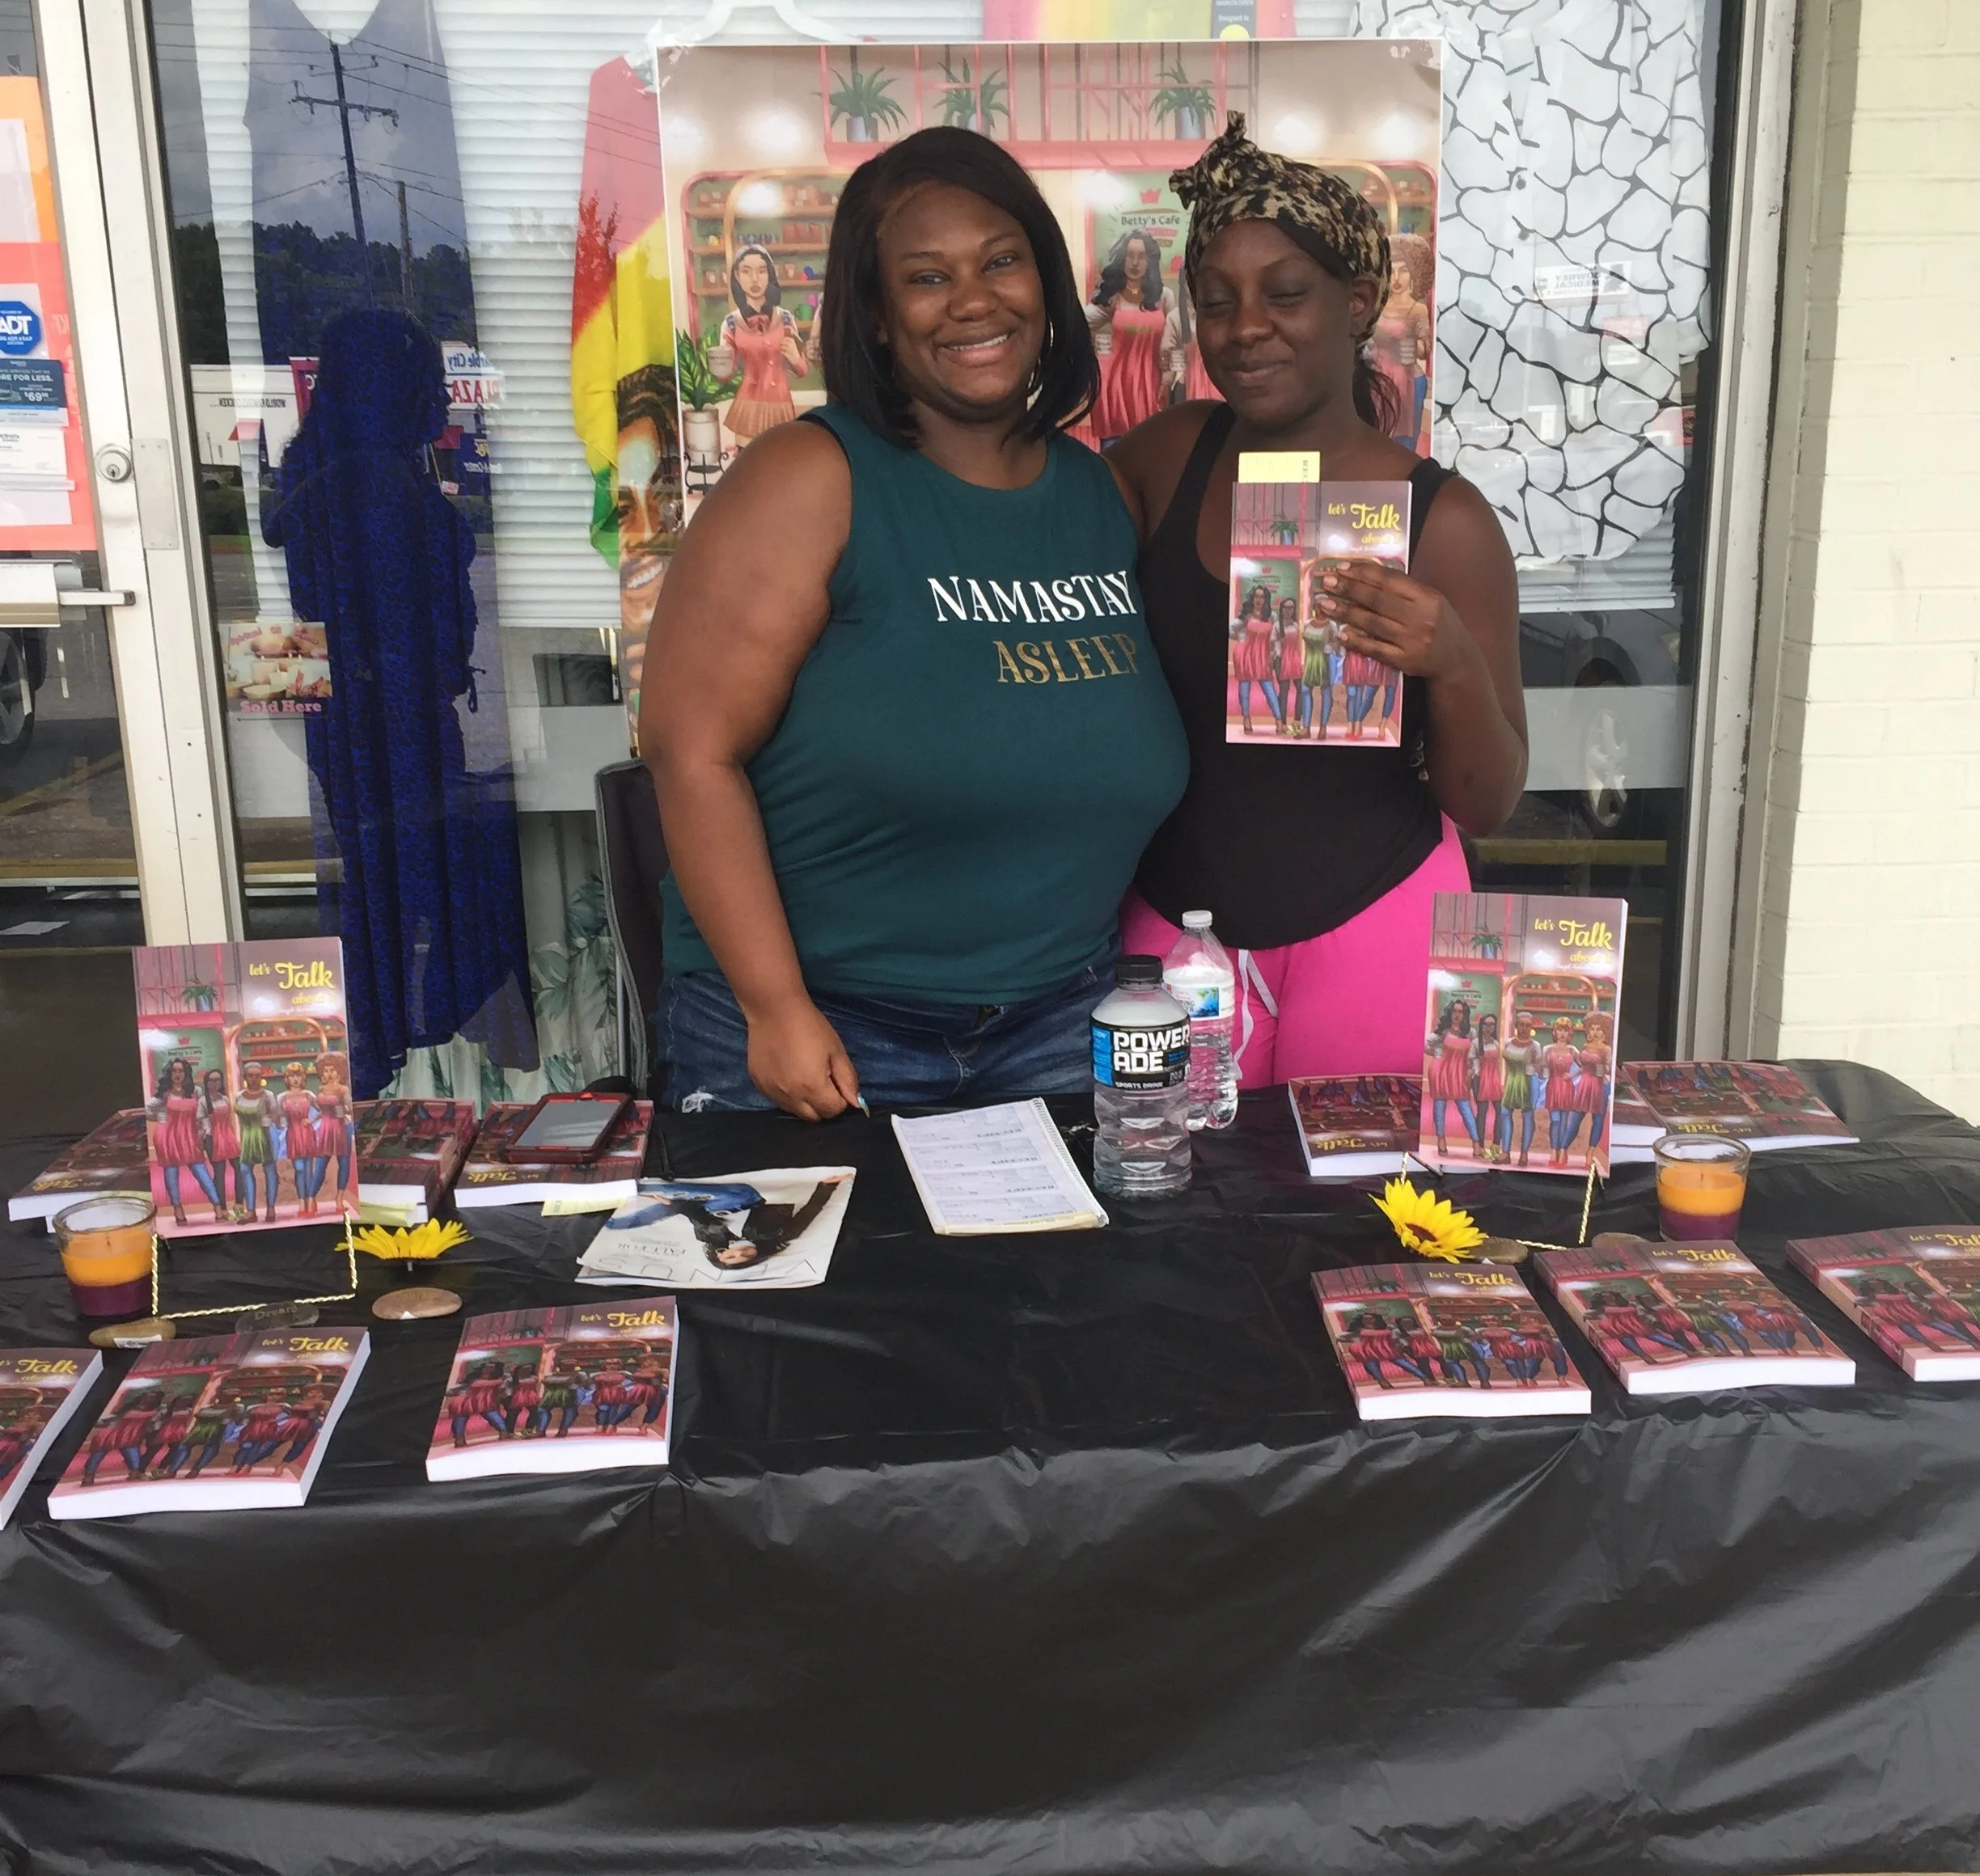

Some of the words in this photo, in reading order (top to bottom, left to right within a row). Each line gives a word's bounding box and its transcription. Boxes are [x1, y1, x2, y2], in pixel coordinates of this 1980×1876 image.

[1121, 214, 1157, 227] Betty's
[0, 315, 32, 335] ADT
[1350, 503, 1402, 531] Talk
[928, 570, 1137, 623] NAMASTAY
[992, 633, 1140, 684] ASLEEP
[239, 700, 279, 712] Sold
[281, 699, 322, 712] Here
[1559, 919, 1614, 950] Talk
[275, 961, 336, 990] Talk
[1113, 1024, 1191, 1052] POWER
[1113, 1050, 1164, 1072] ADE
[1934, 1234, 1980, 1247] Tal
[1677, 1249, 1744, 1262] Talk
[1454, 1271, 1518, 1287] Talk
[607, 1310, 667, 1327] Talk
[289, 1337, 349, 1352] Talk
[15, 1358, 78, 1375] Talk
